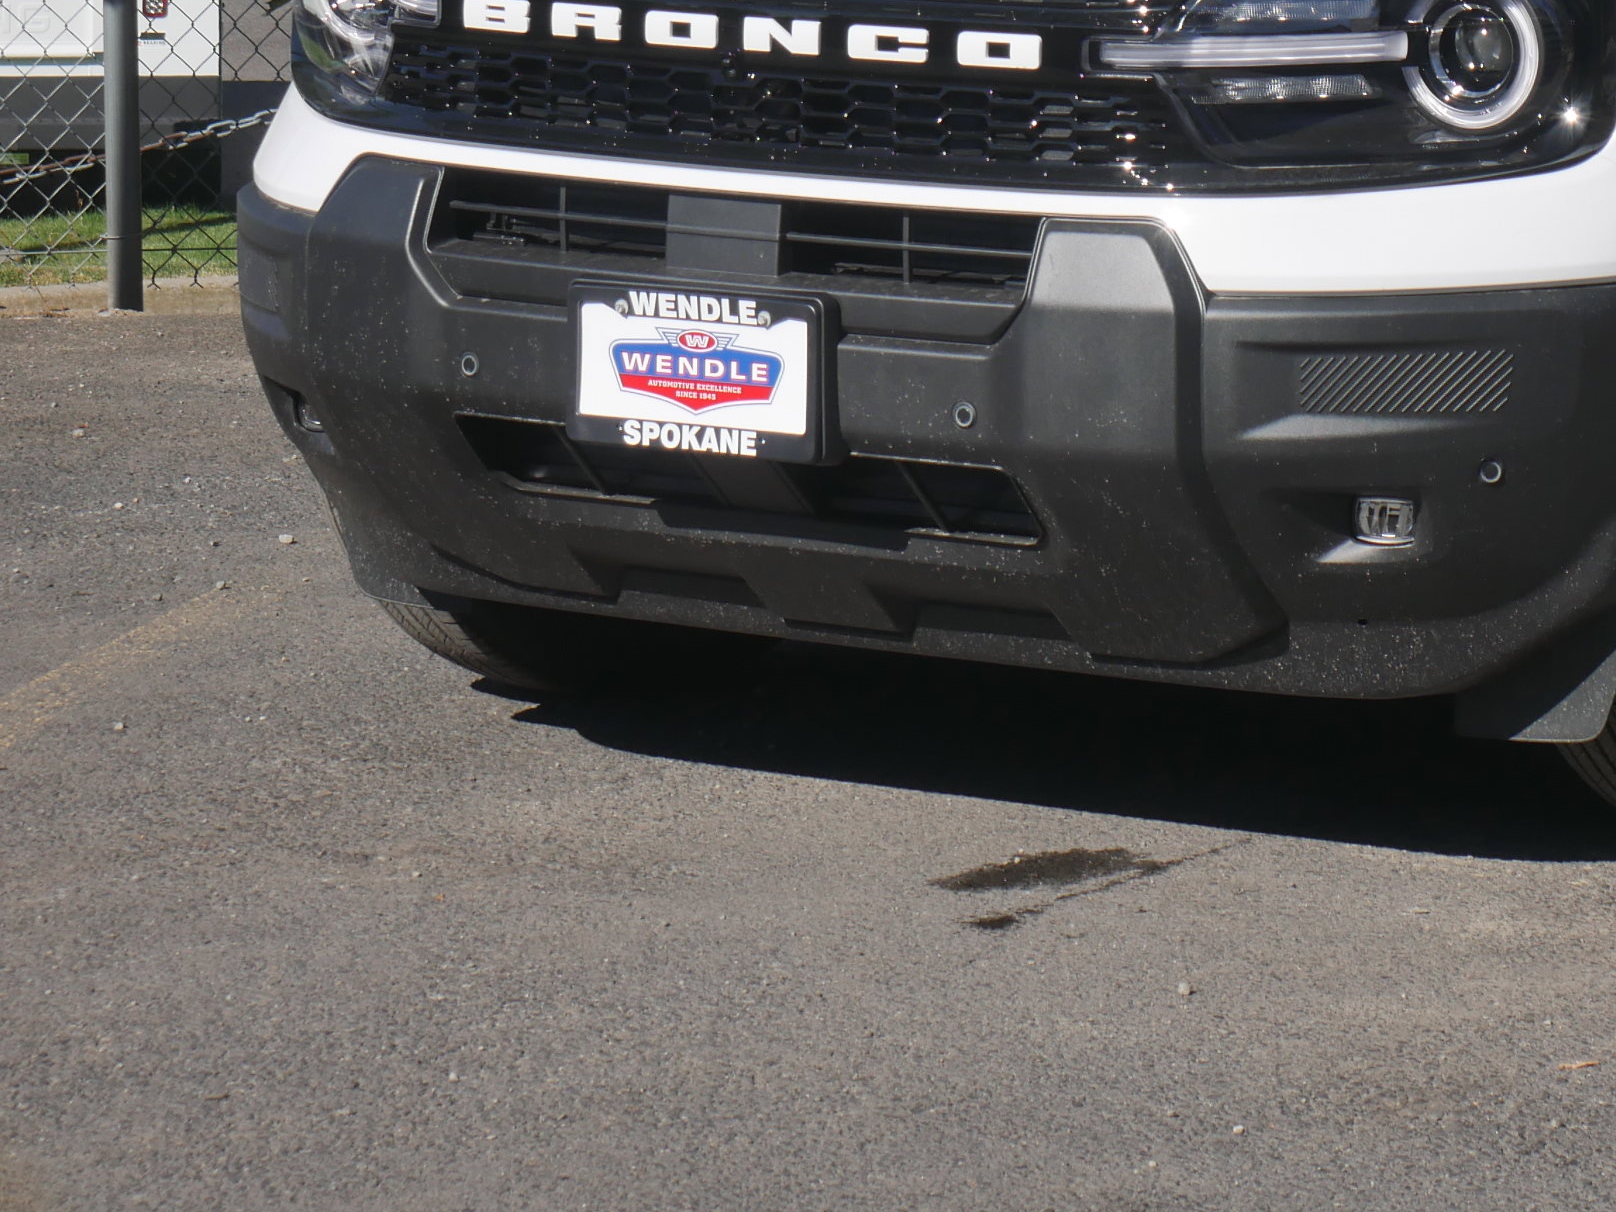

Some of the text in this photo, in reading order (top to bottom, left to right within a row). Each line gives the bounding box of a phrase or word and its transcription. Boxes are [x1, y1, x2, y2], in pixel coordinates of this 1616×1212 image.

[629, 291, 758, 325] WENDLE
[621, 351, 769, 382] WENDLE
[647, 379, 742, 394] AUTOMOTIVE EXCELLENCE
[675, 390, 698, 399] SINCE
[623, 420, 757, 456] SPOKANE
